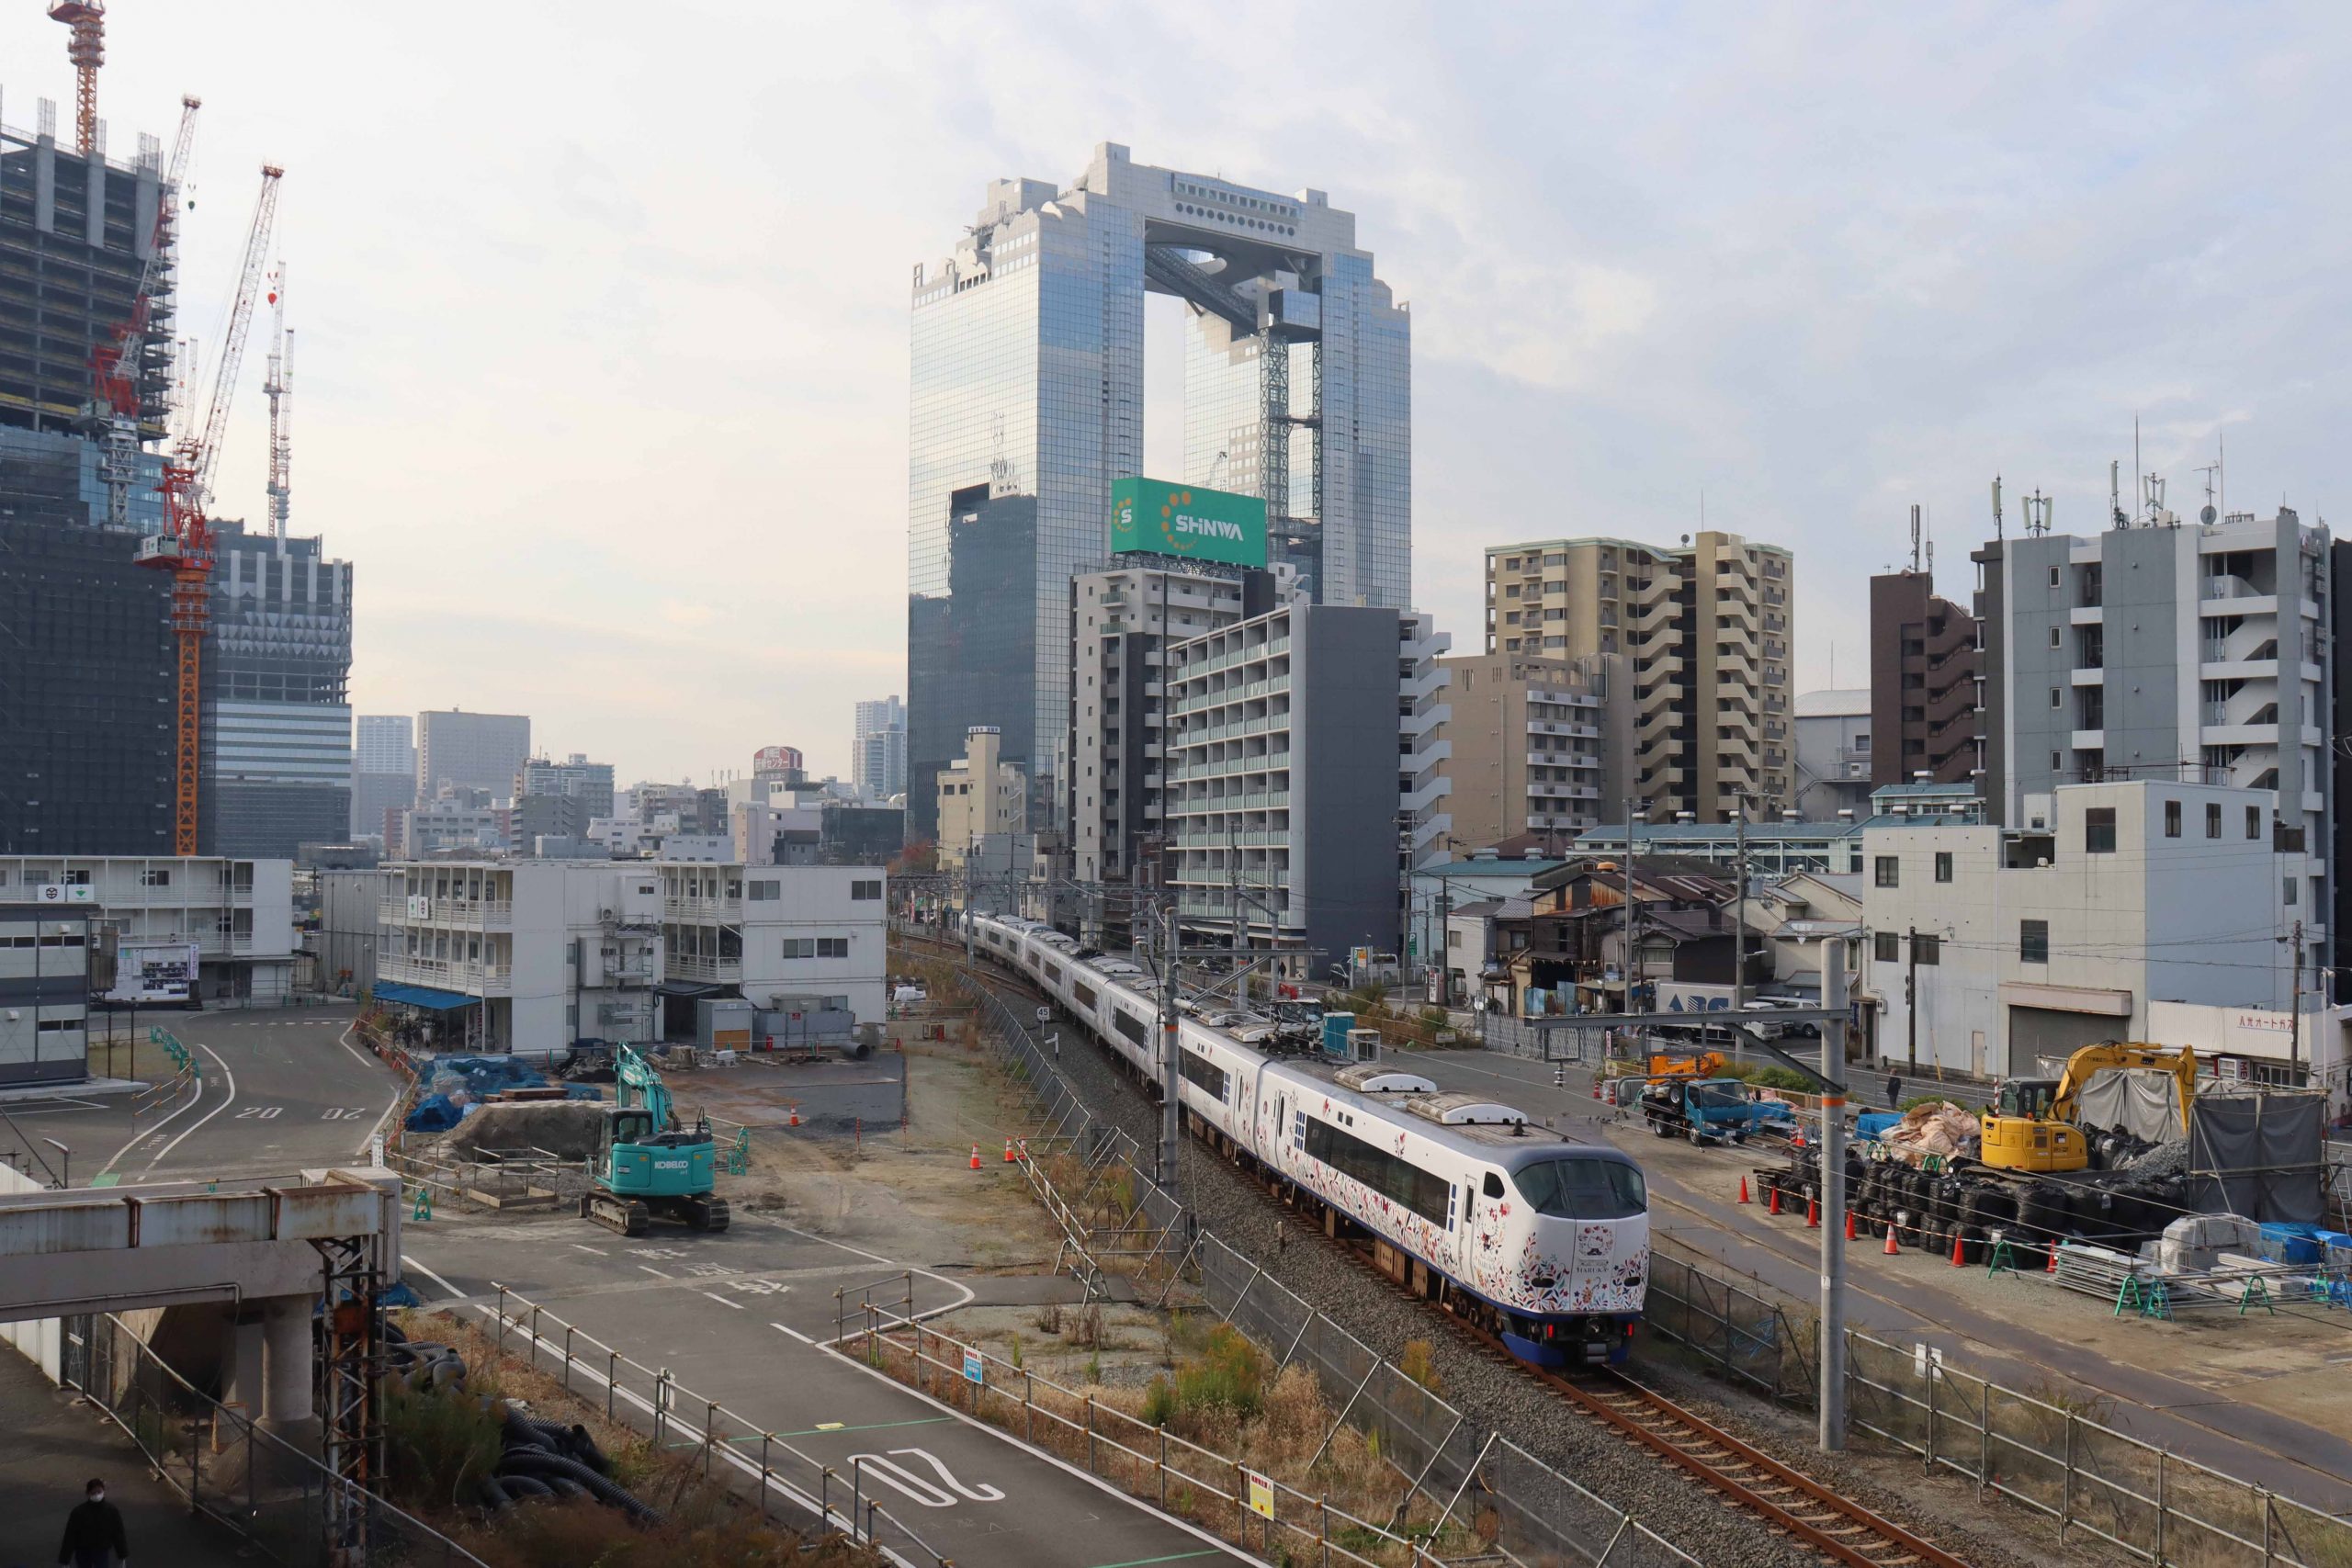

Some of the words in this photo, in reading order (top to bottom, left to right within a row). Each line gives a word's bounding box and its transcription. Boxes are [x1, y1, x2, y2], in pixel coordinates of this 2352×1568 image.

[1121, 508, 1132, 525] S
[1038, 1008, 1048, 1016] 45
[234, 1107, 284, 1119] 20
[654, 1160, 689, 1169] KOBELCO
[847, 1448, 1006, 1507] 20
